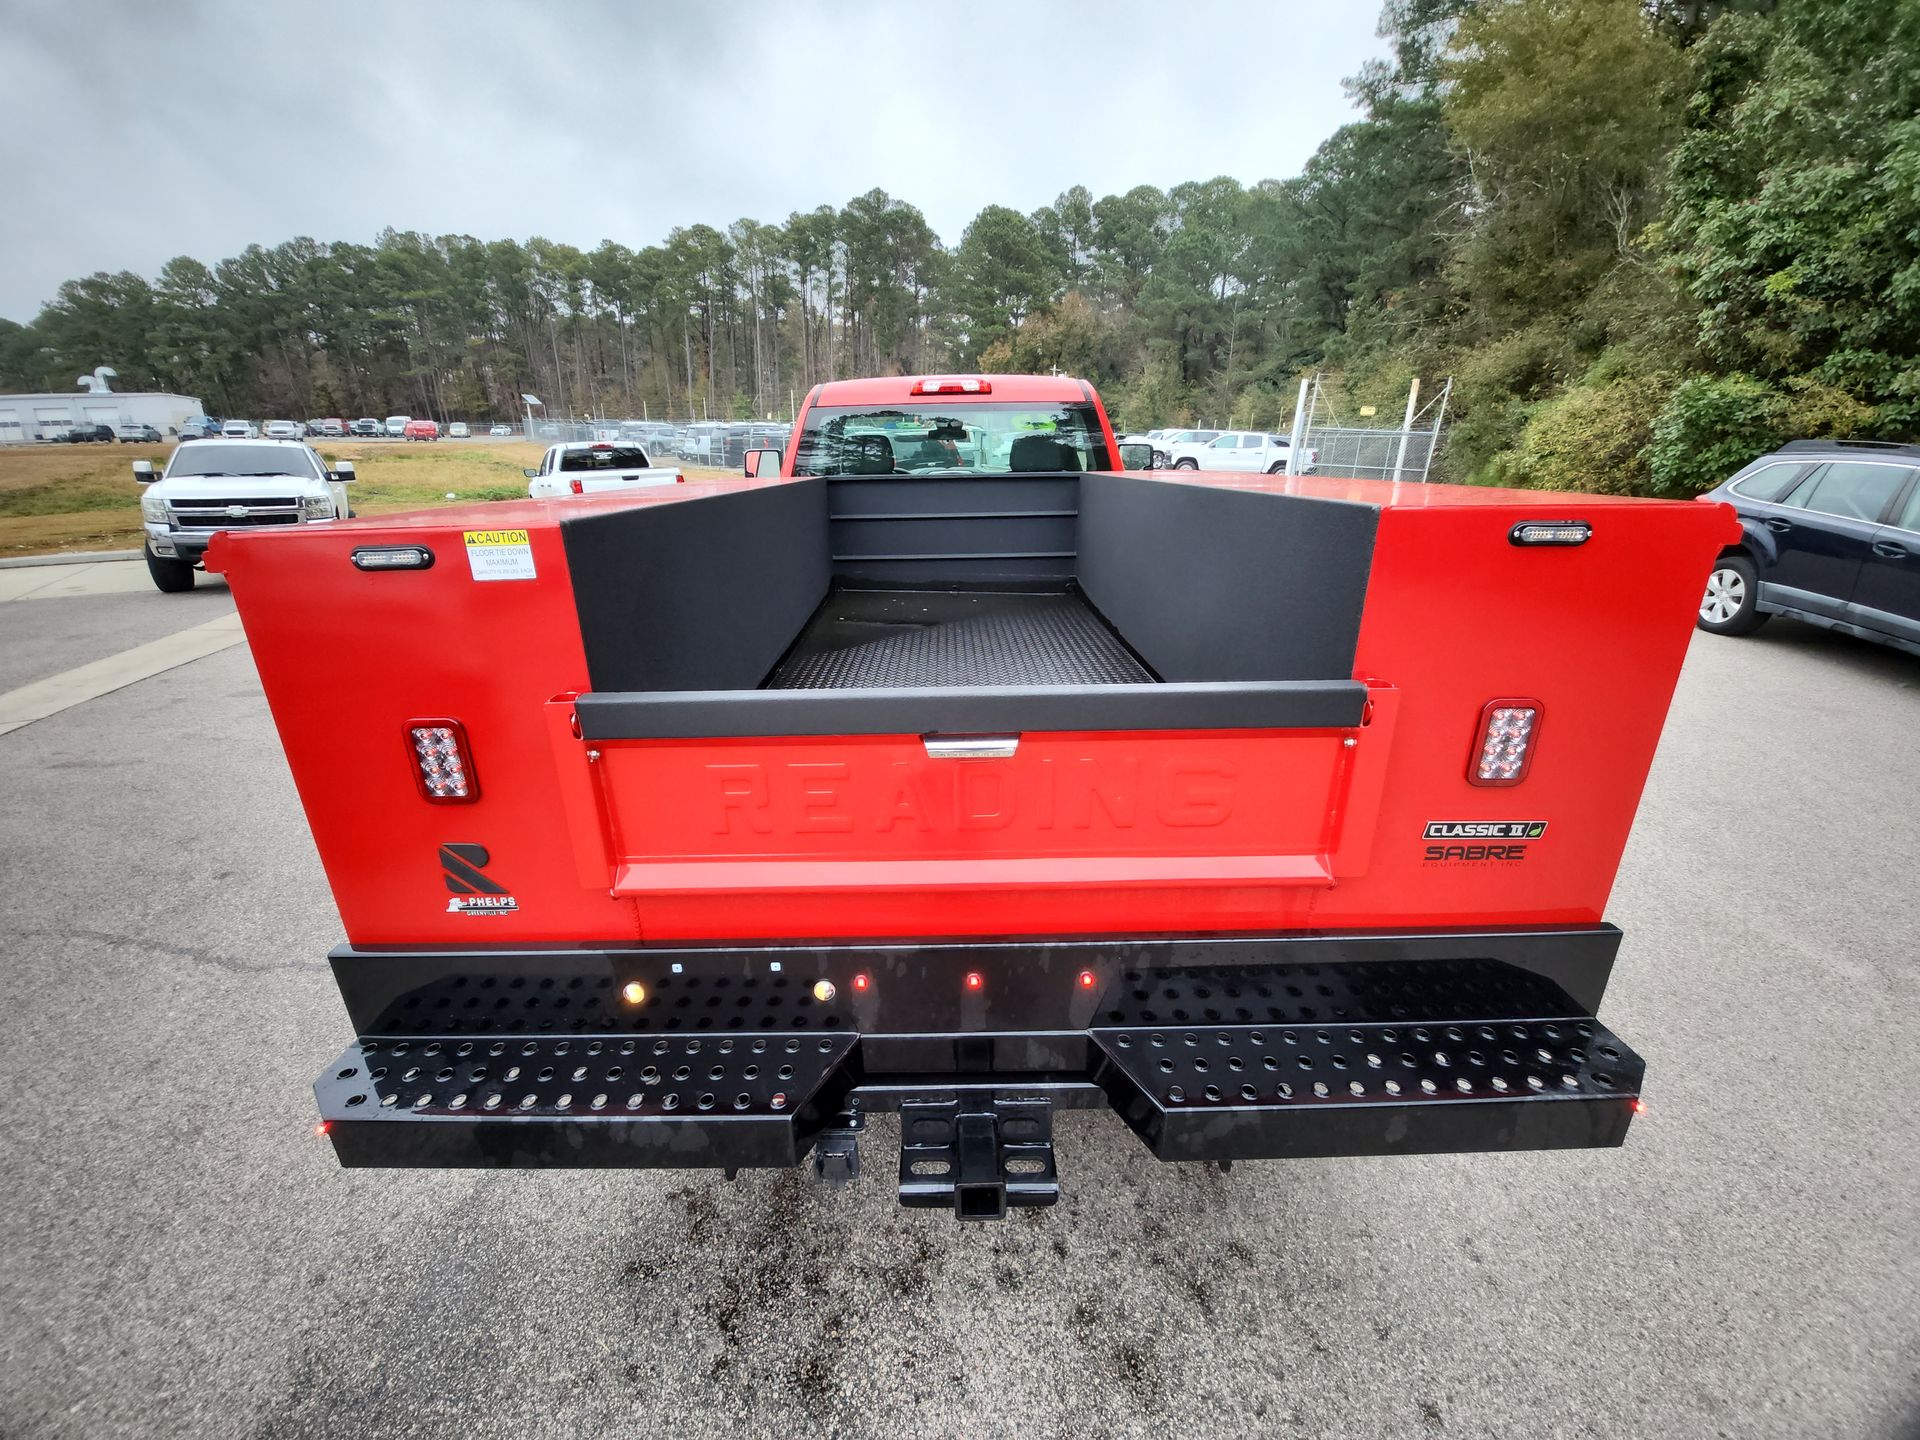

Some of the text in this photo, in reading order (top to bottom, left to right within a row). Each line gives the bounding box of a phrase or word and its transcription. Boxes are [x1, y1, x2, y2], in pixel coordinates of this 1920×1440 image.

[476, 532, 527, 543] CAUTION
[471, 547, 529, 557] FLOOR TIE DOWN
[485, 558, 519, 567] MAXIMUM
[705, 757, 1237, 834] READING
[1429, 824, 1525, 836] CLASSIC II
[1424, 845, 1527, 860] SABRE
[468, 896, 517, 906] PHELPS
